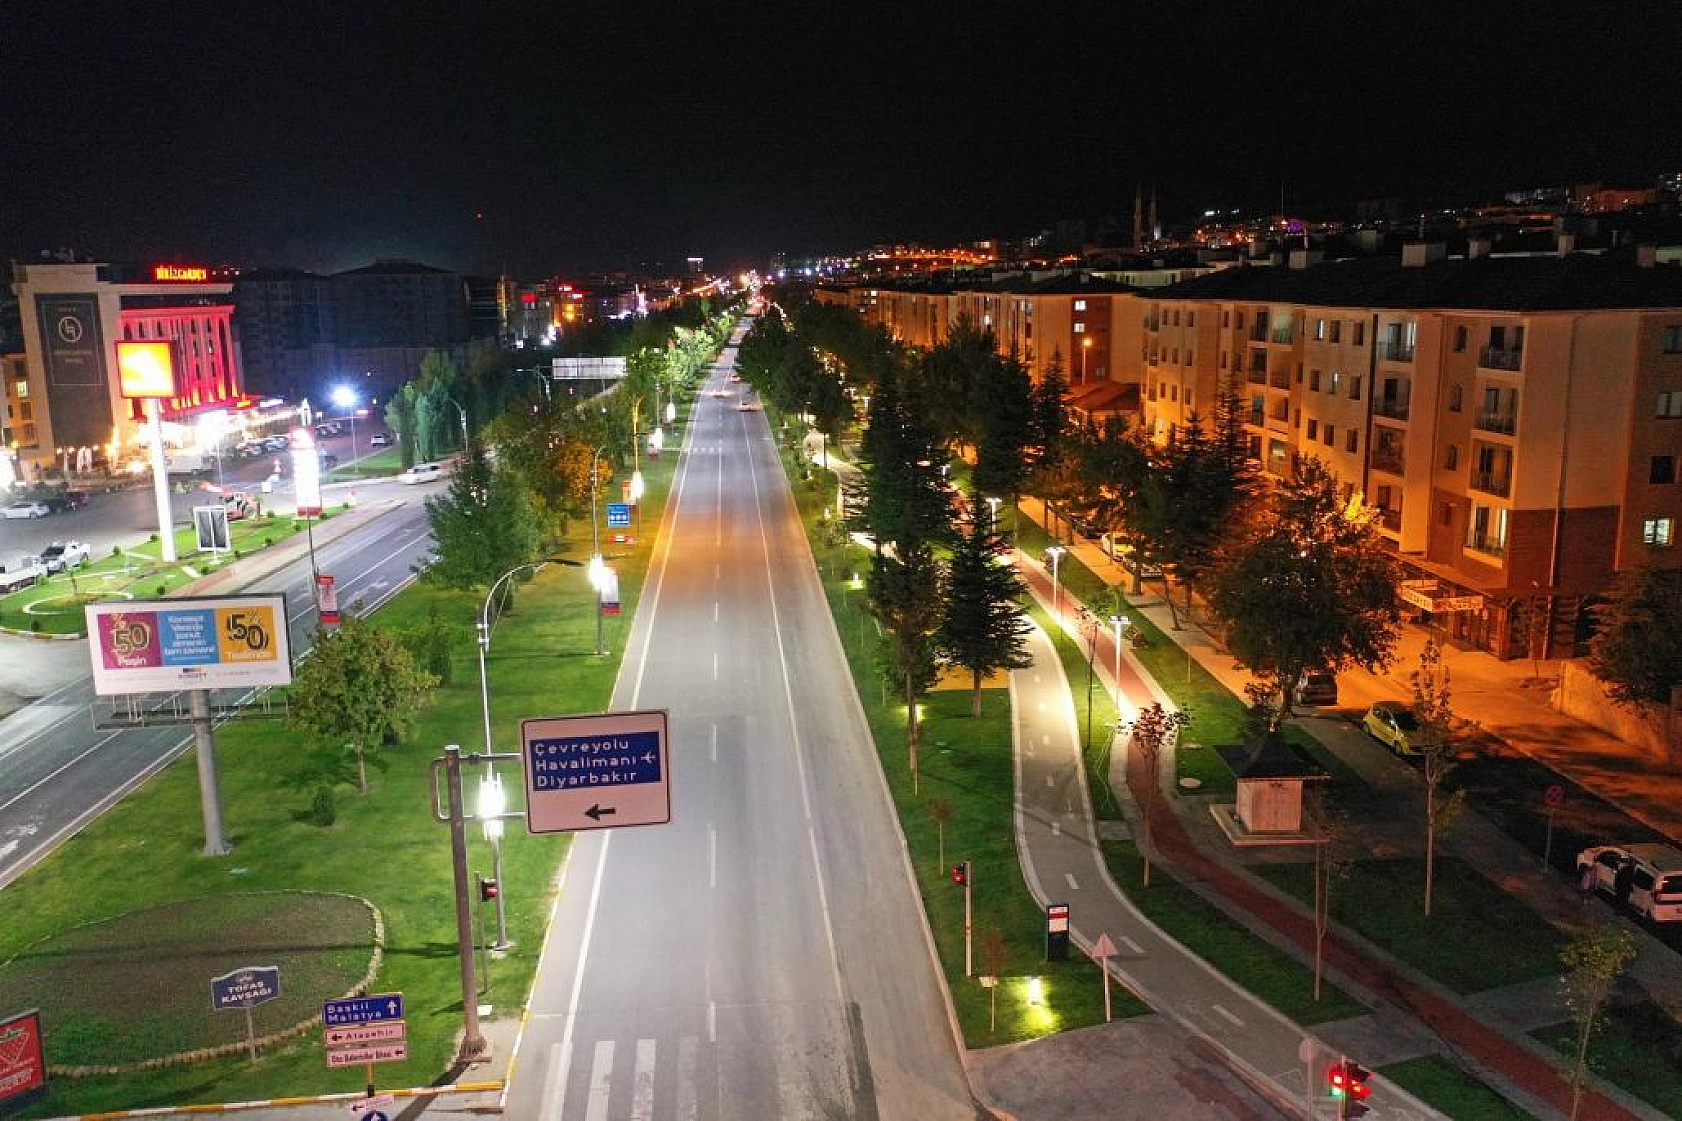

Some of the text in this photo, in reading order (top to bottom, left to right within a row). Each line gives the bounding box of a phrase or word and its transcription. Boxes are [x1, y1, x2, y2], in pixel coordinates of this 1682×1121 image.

[535, 739, 629, 755] Çevreyolu
[535, 756, 637, 771] Havalimanı
[537, 771, 637, 788] Diyarbakır
[327, 1002, 369, 1013] Baskil
[327, 1011, 382, 1023] Malatya
